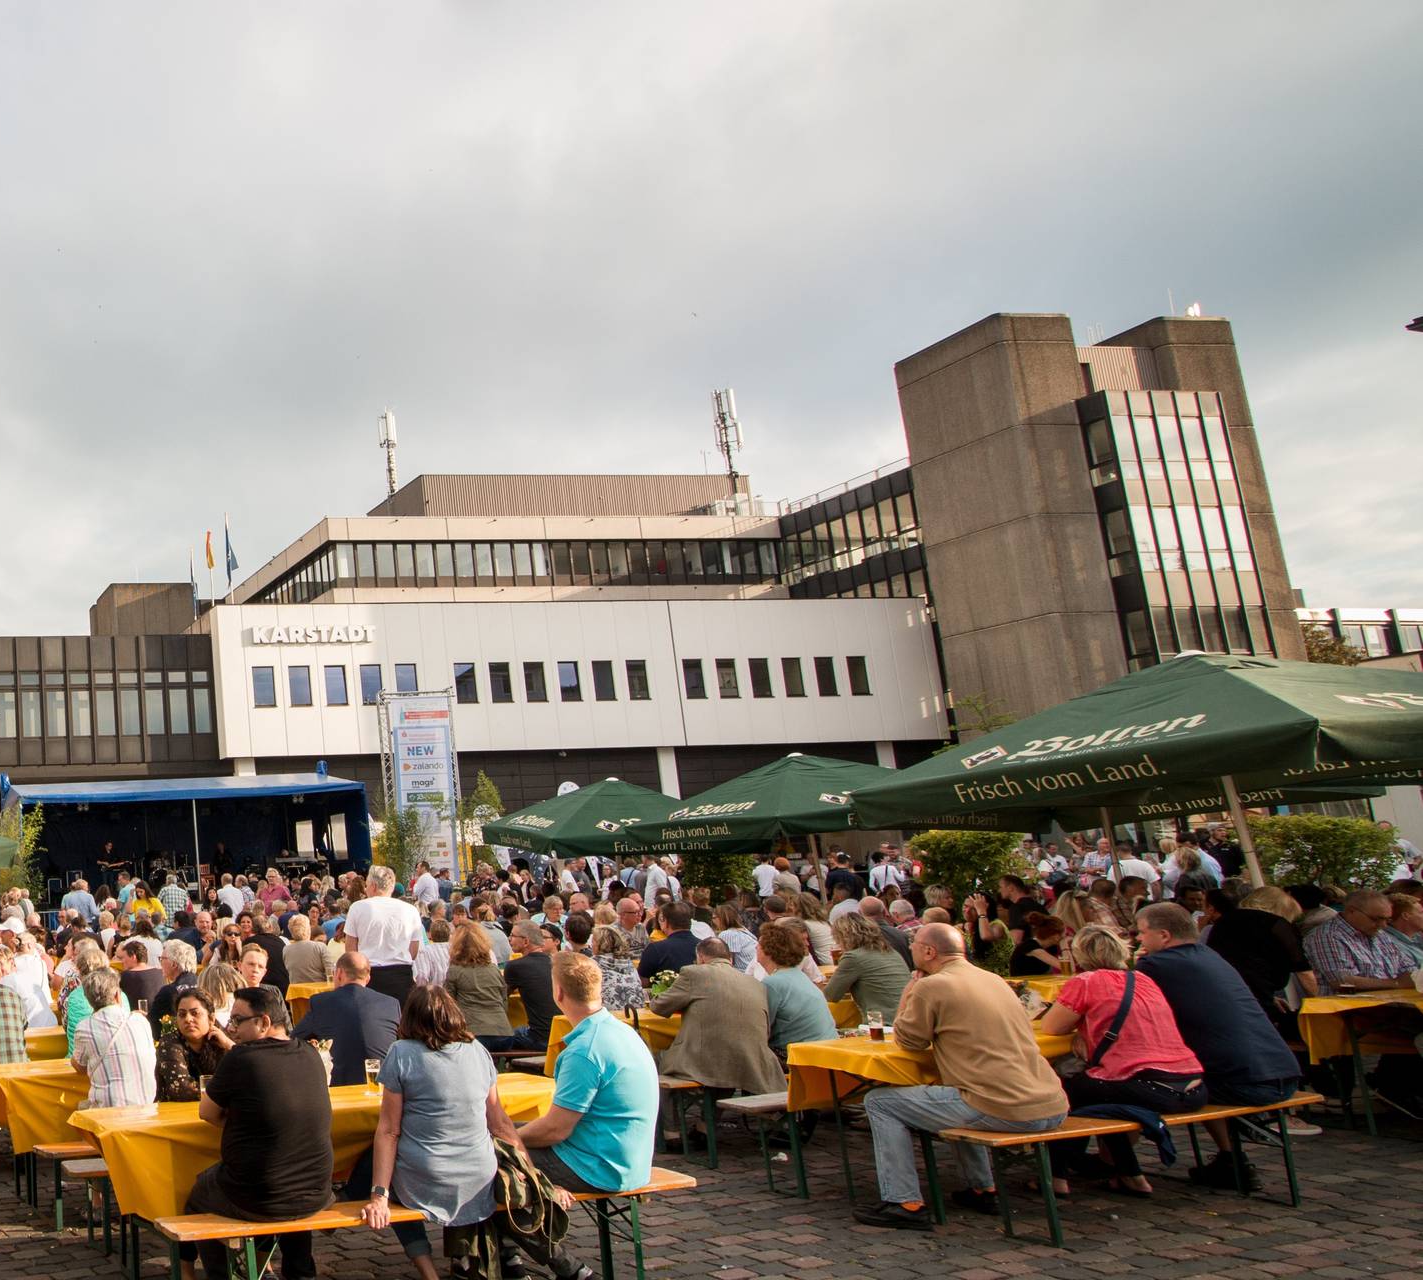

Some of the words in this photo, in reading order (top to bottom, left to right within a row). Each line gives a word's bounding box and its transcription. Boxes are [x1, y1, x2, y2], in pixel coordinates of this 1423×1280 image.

[252, 624, 376, 644] KARSTADT
[1007, 713, 1207, 760] Bolten
[407, 745, 434, 756] NEW
[413, 761, 444, 769] zalando
[954, 775, 1023, 804] Frisch
[1026, 770, 1084, 792] vom
[1086, 754, 1167, 784] Land.
[662, 828, 685, 840] Frisch
[686, 827, 706, 837] vom
[707, 823, 731, 836] Land.
